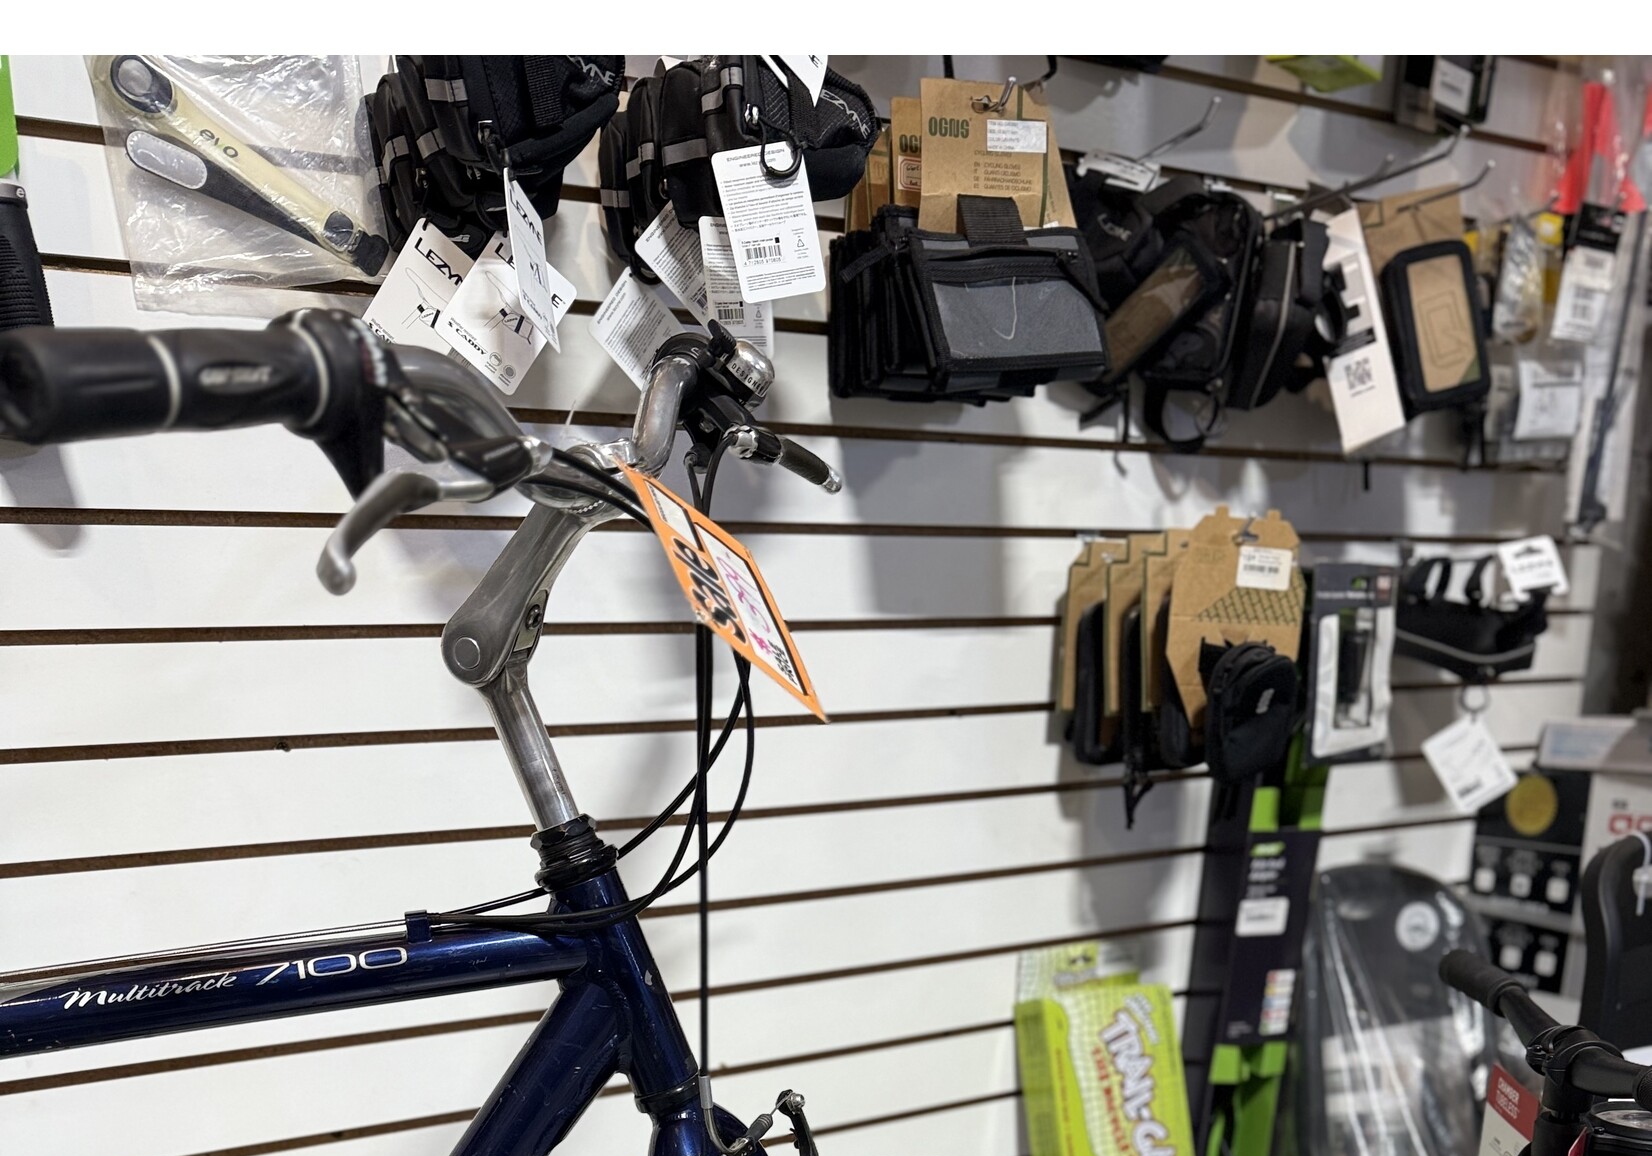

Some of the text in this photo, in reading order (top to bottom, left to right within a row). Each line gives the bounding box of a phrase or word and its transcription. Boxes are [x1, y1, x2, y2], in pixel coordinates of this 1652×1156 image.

[820, 88, 871, 139] EZYNE
[928, 116, 970, 139] OGNS
[899, 133, 921, 153] OG
[414, 236, 464, 287] LEZY
[62, 946, 409, 1010] Multitrack 7100
